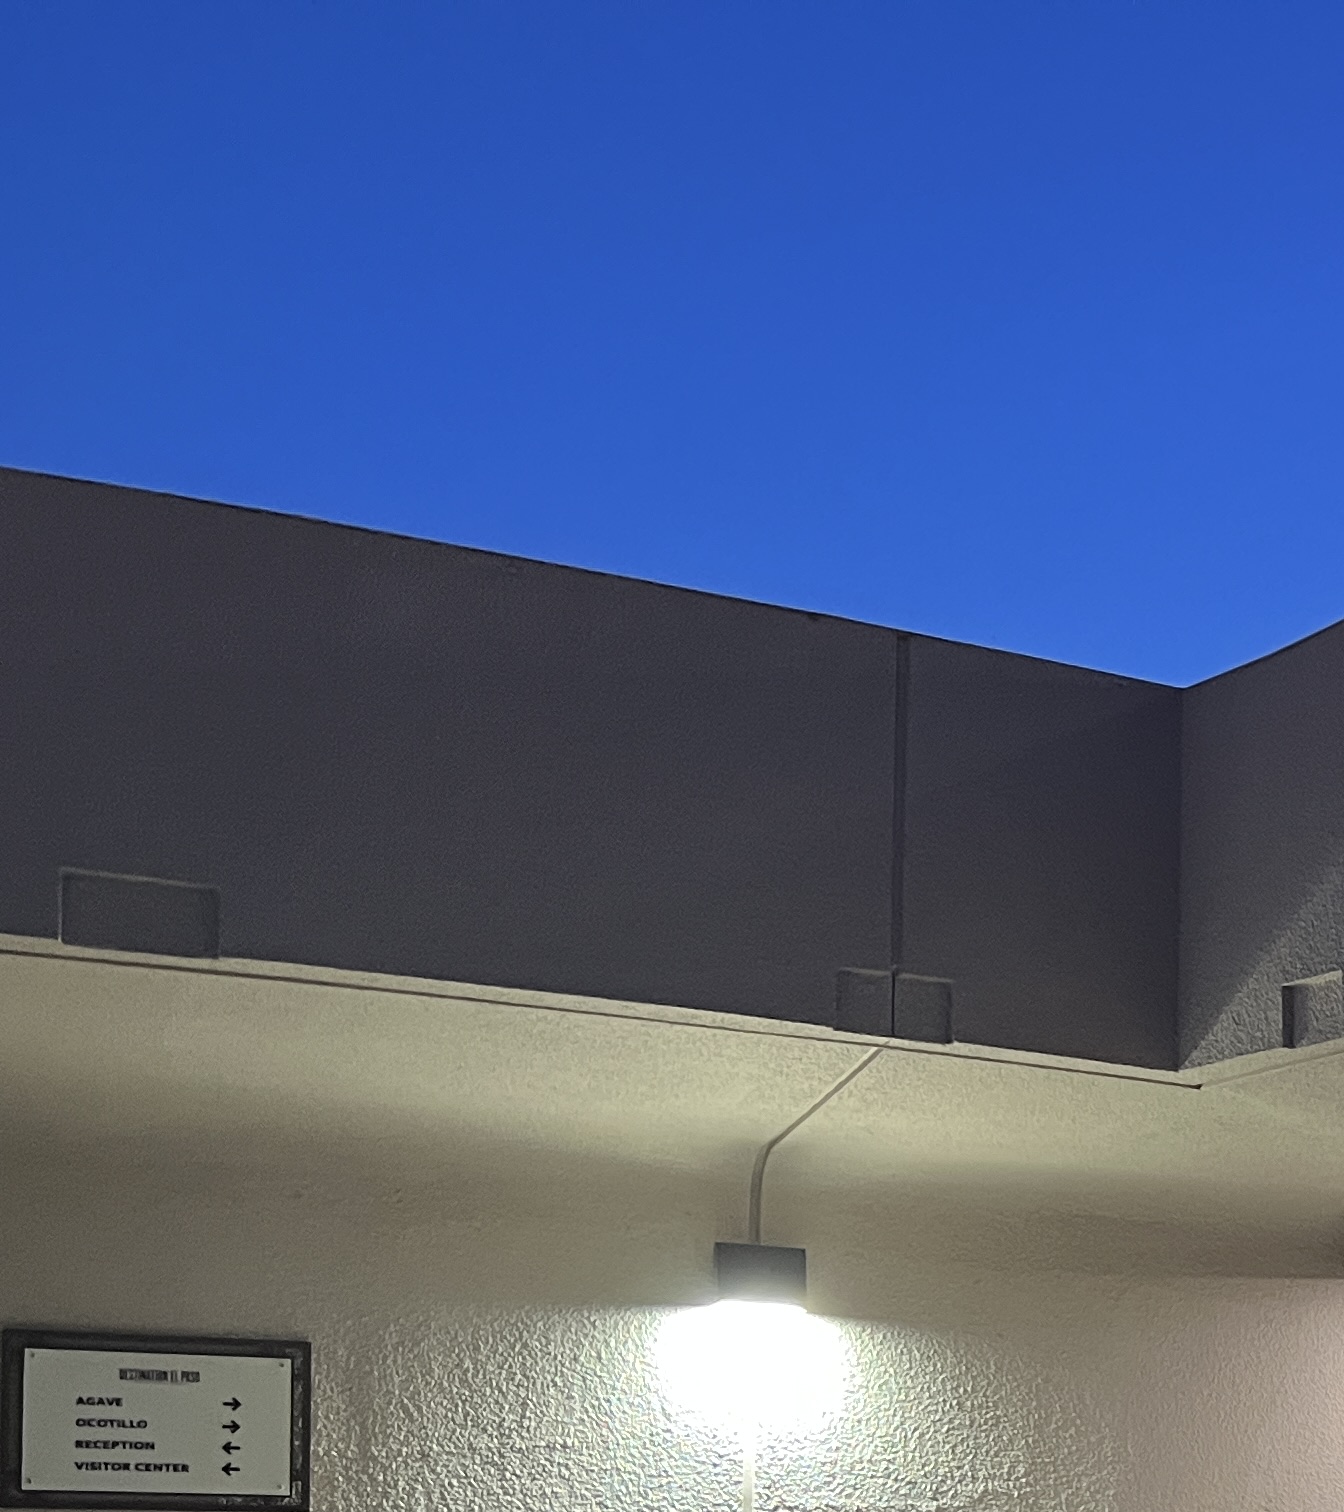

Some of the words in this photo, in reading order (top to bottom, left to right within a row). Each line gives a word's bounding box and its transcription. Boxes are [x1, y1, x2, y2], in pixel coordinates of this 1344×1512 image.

[76, 1396, 123, 1407] AGAVE
[75, 1418, 148, 1429] OCOTILLO
[75, 1440, 155, 1450] RECEPTION
[74, 1461, 131, 1472] VISITOR
[134, 1462, 190, 1473] CENTER
